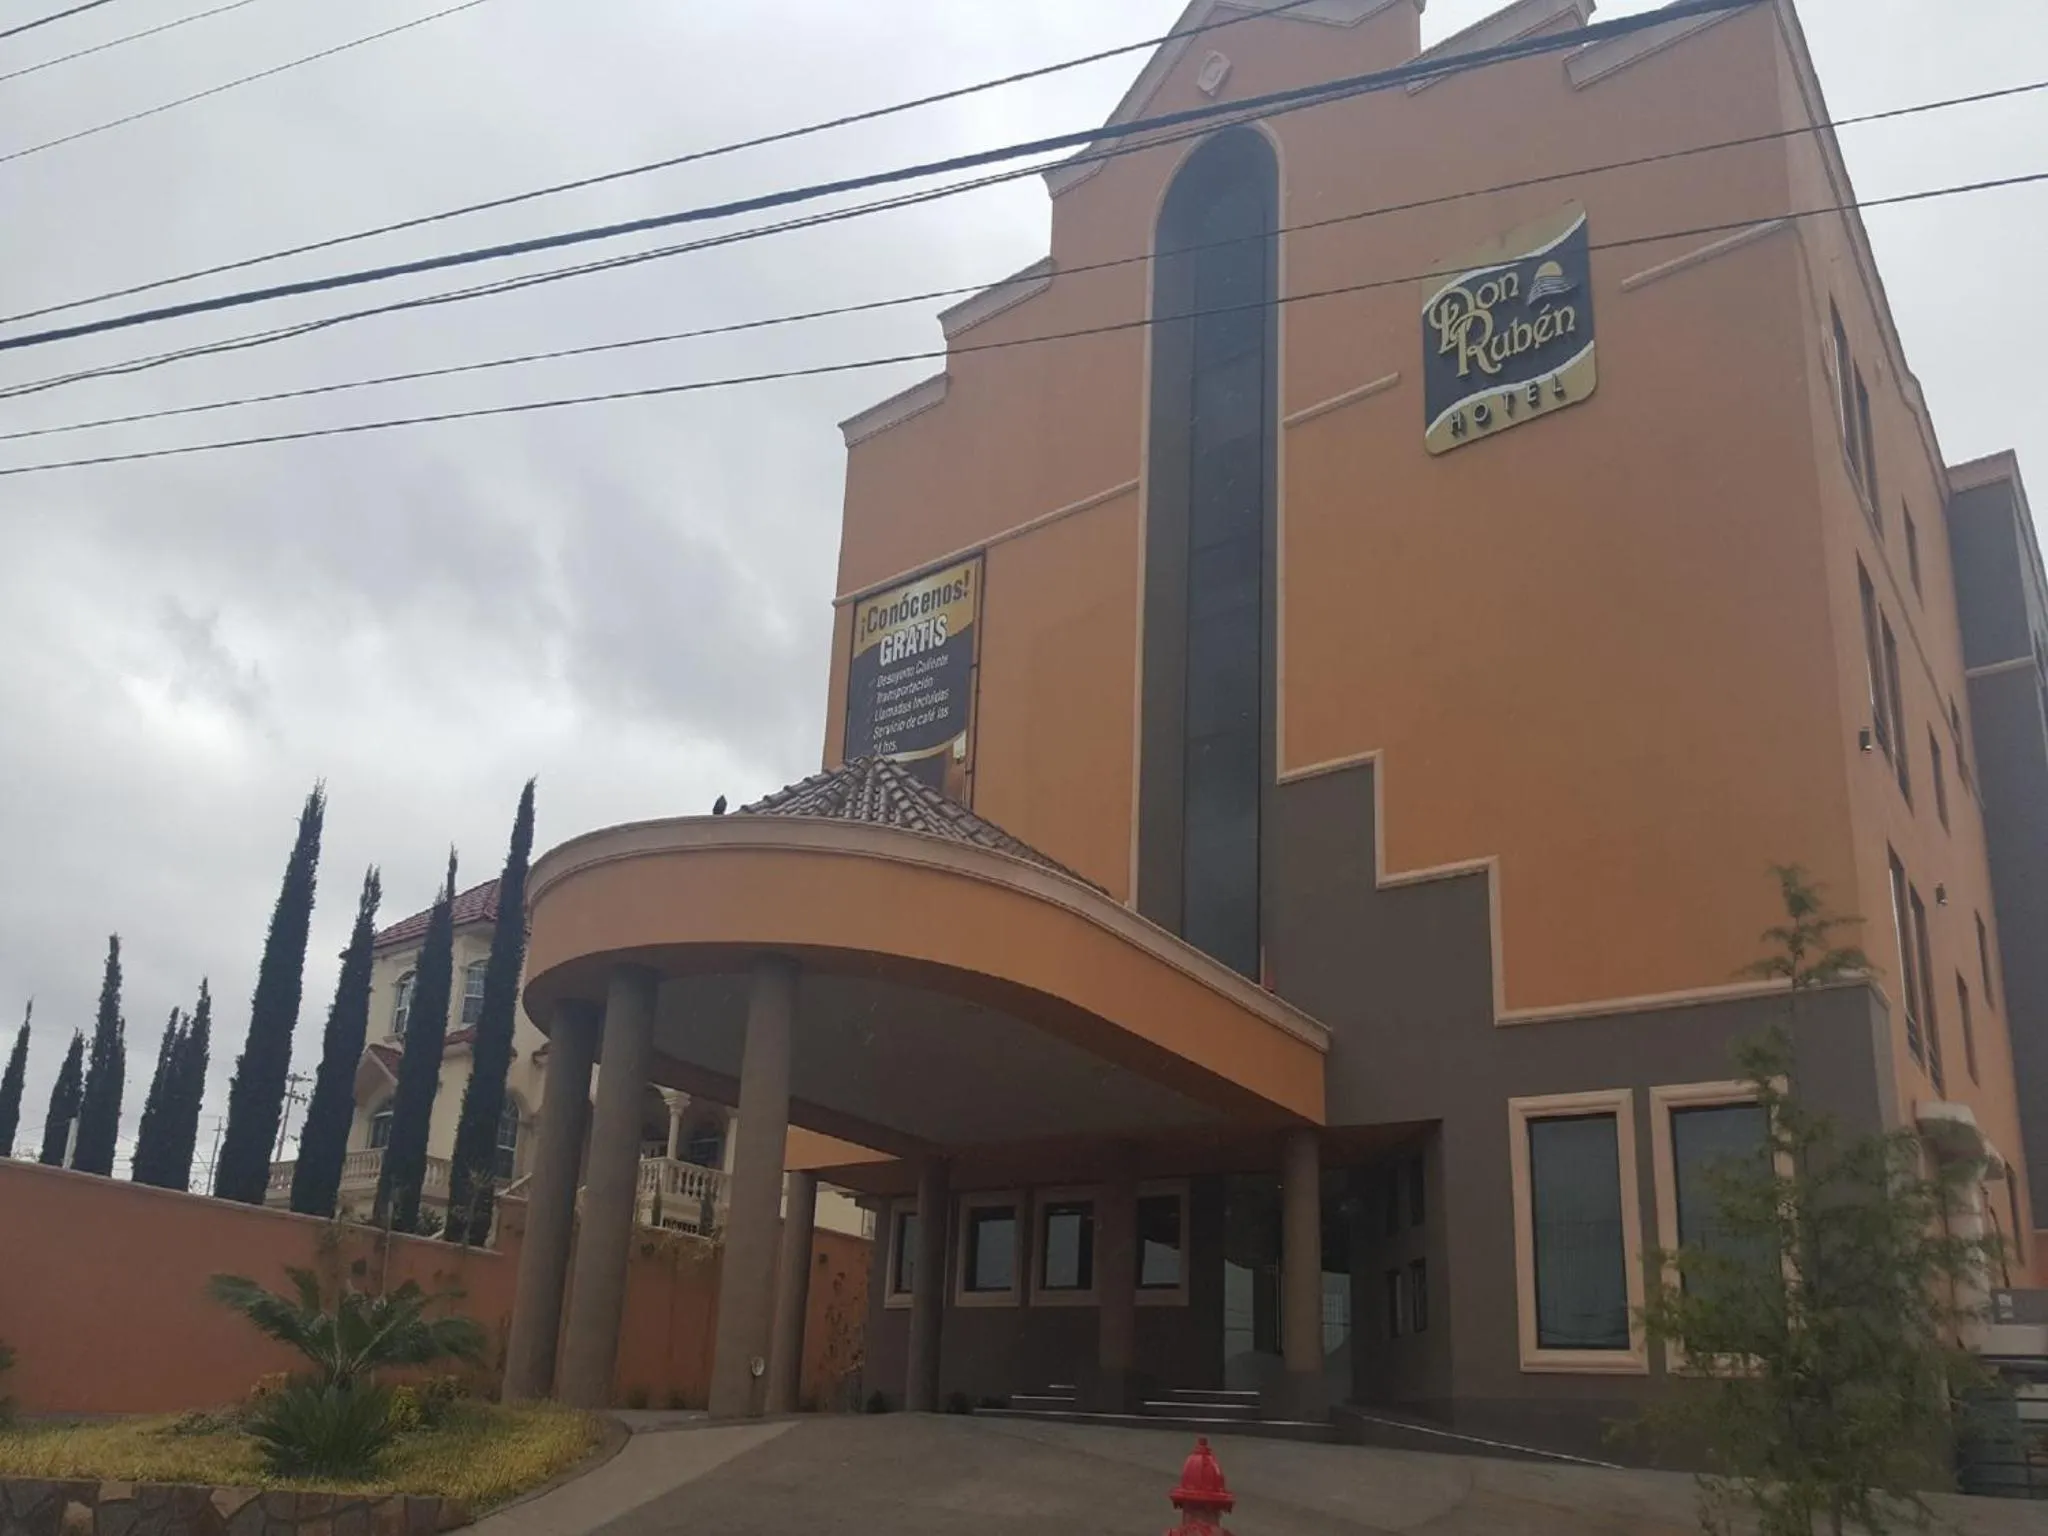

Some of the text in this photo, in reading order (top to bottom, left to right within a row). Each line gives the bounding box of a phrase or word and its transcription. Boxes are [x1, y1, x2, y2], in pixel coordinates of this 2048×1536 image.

[1428, 272, 1520, 354] Don
[1455, 303, 1577, 378] Rubén
[1450, 373, 1567, 437] HOTEL
[860, 569, 970, 642] ¡Conócenos!
[879, 614, 948, 666] GRATIS
[906, 715, 916, 729] de
